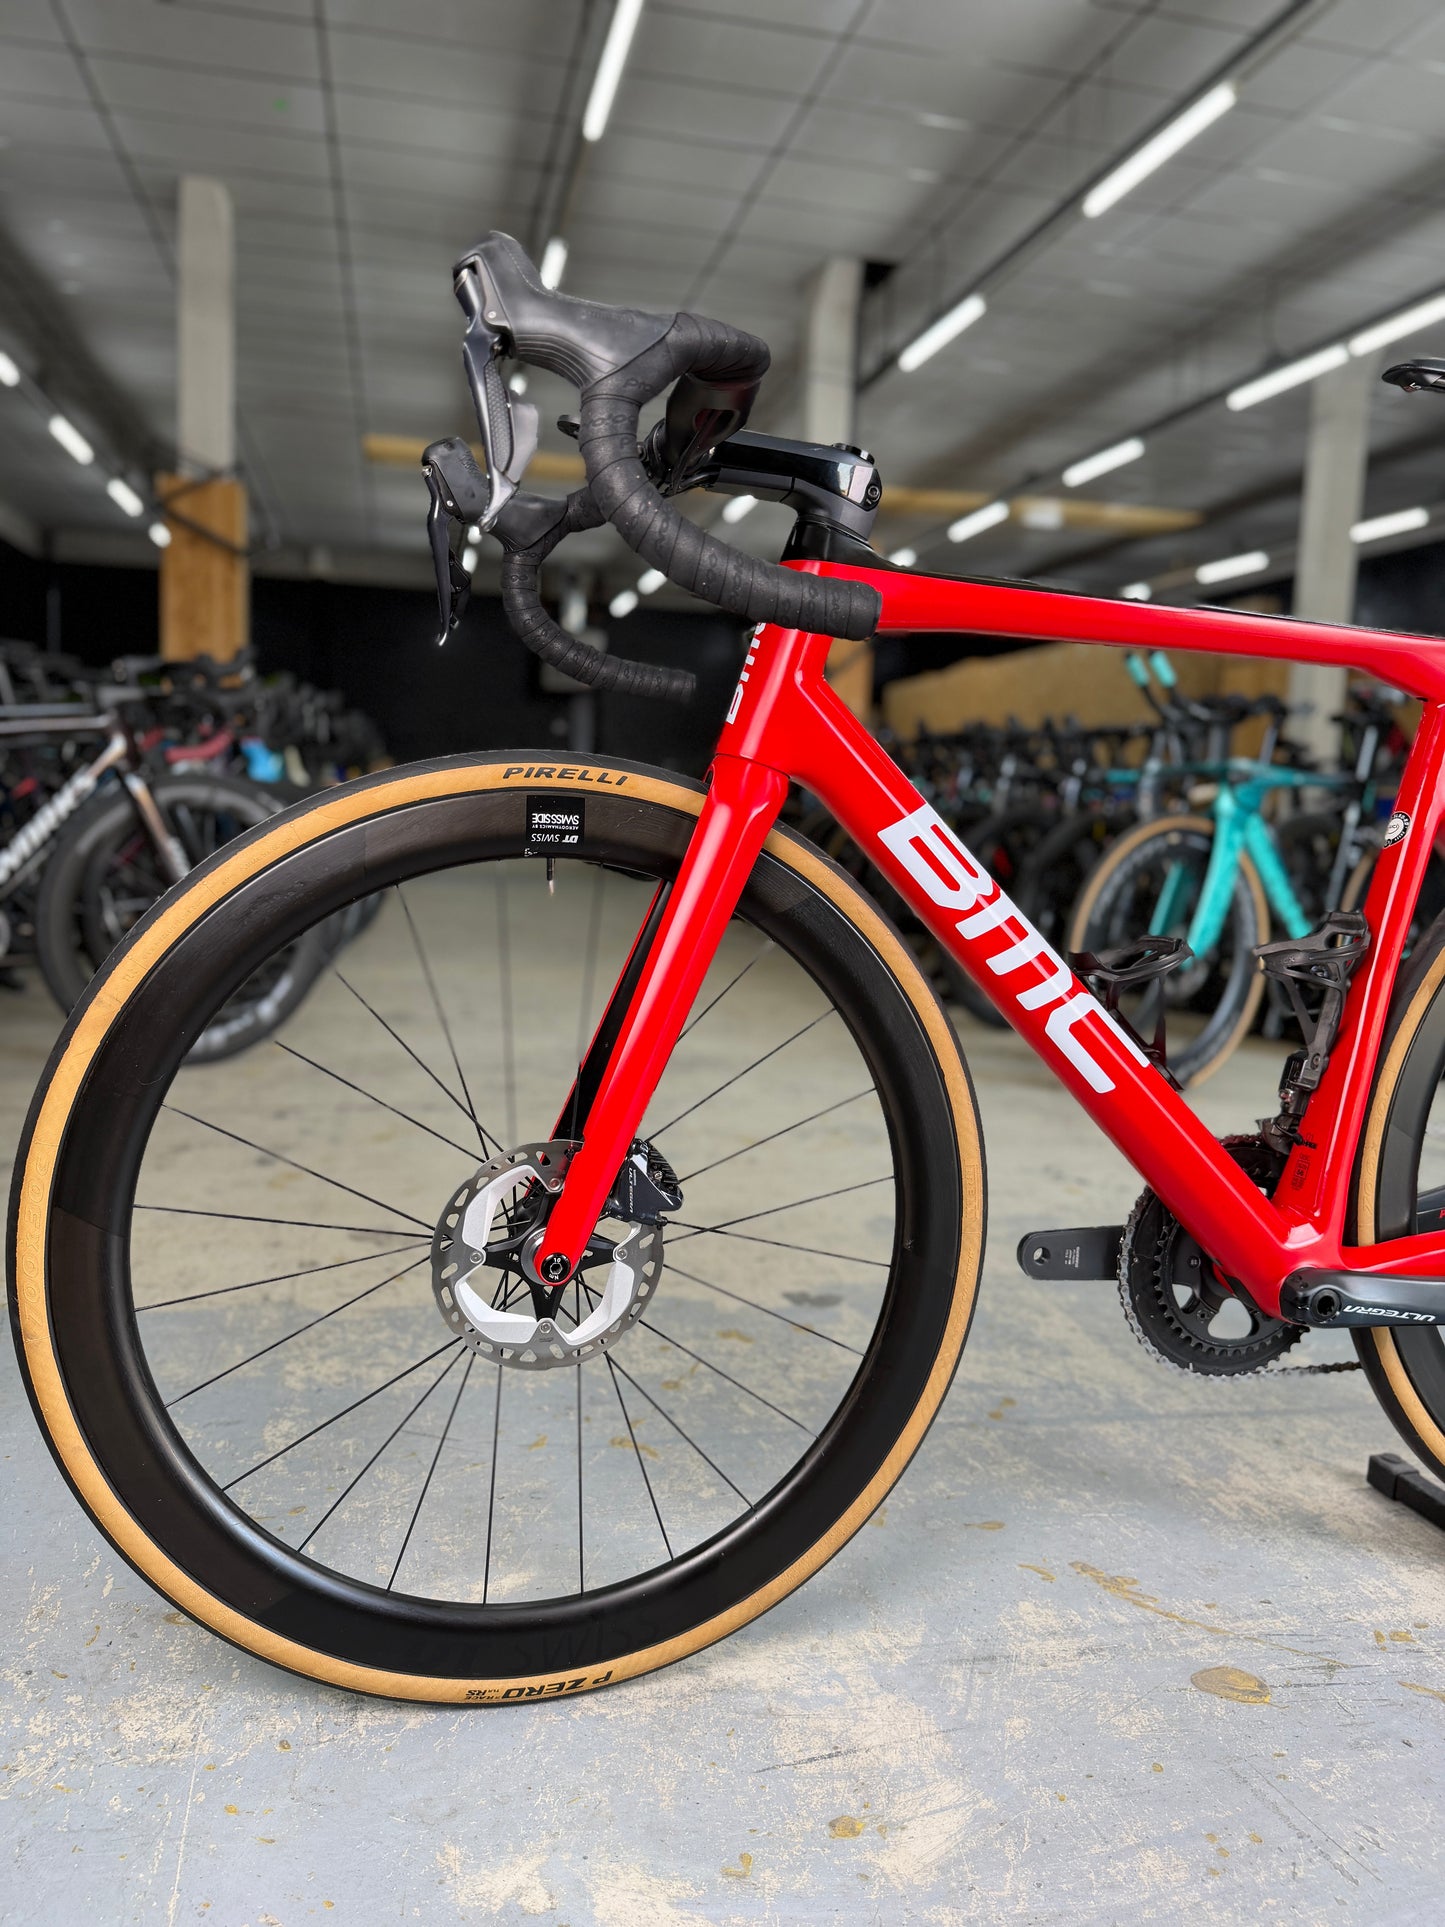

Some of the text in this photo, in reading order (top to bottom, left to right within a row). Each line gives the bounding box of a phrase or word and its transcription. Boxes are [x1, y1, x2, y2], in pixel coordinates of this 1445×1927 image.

[502, 766, 629, 786] PIRELLI
[531, 833, 579, 844] DT SWISS
[1342, 1304, 1437, 1324] ULTEGRA
[501, 1670, 614, 1699] P ZERO
